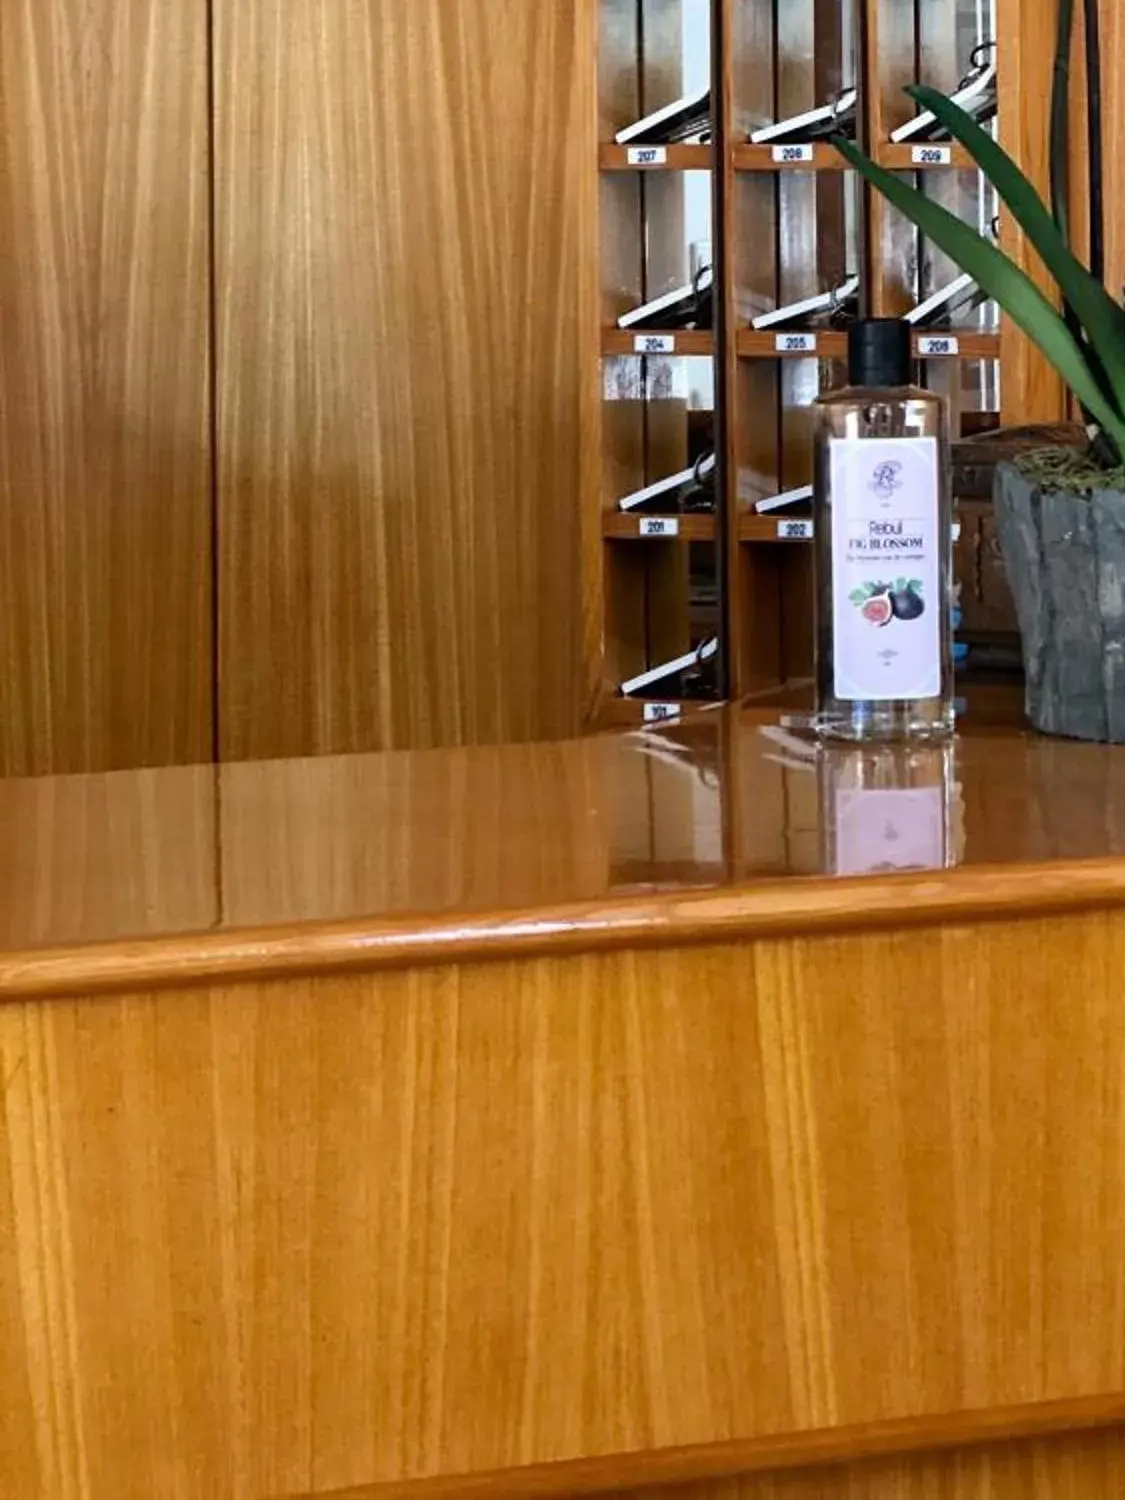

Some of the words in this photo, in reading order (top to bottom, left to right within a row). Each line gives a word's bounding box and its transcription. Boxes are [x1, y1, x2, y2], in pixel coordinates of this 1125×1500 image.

[920, 149, 942, 161] 209
[645, 338, 665, 350] 204
[647, 520, 665, 532] 201
[869, 520, 902, 536] Rebul
[869, 537, 923, 549] BLOSSOM
